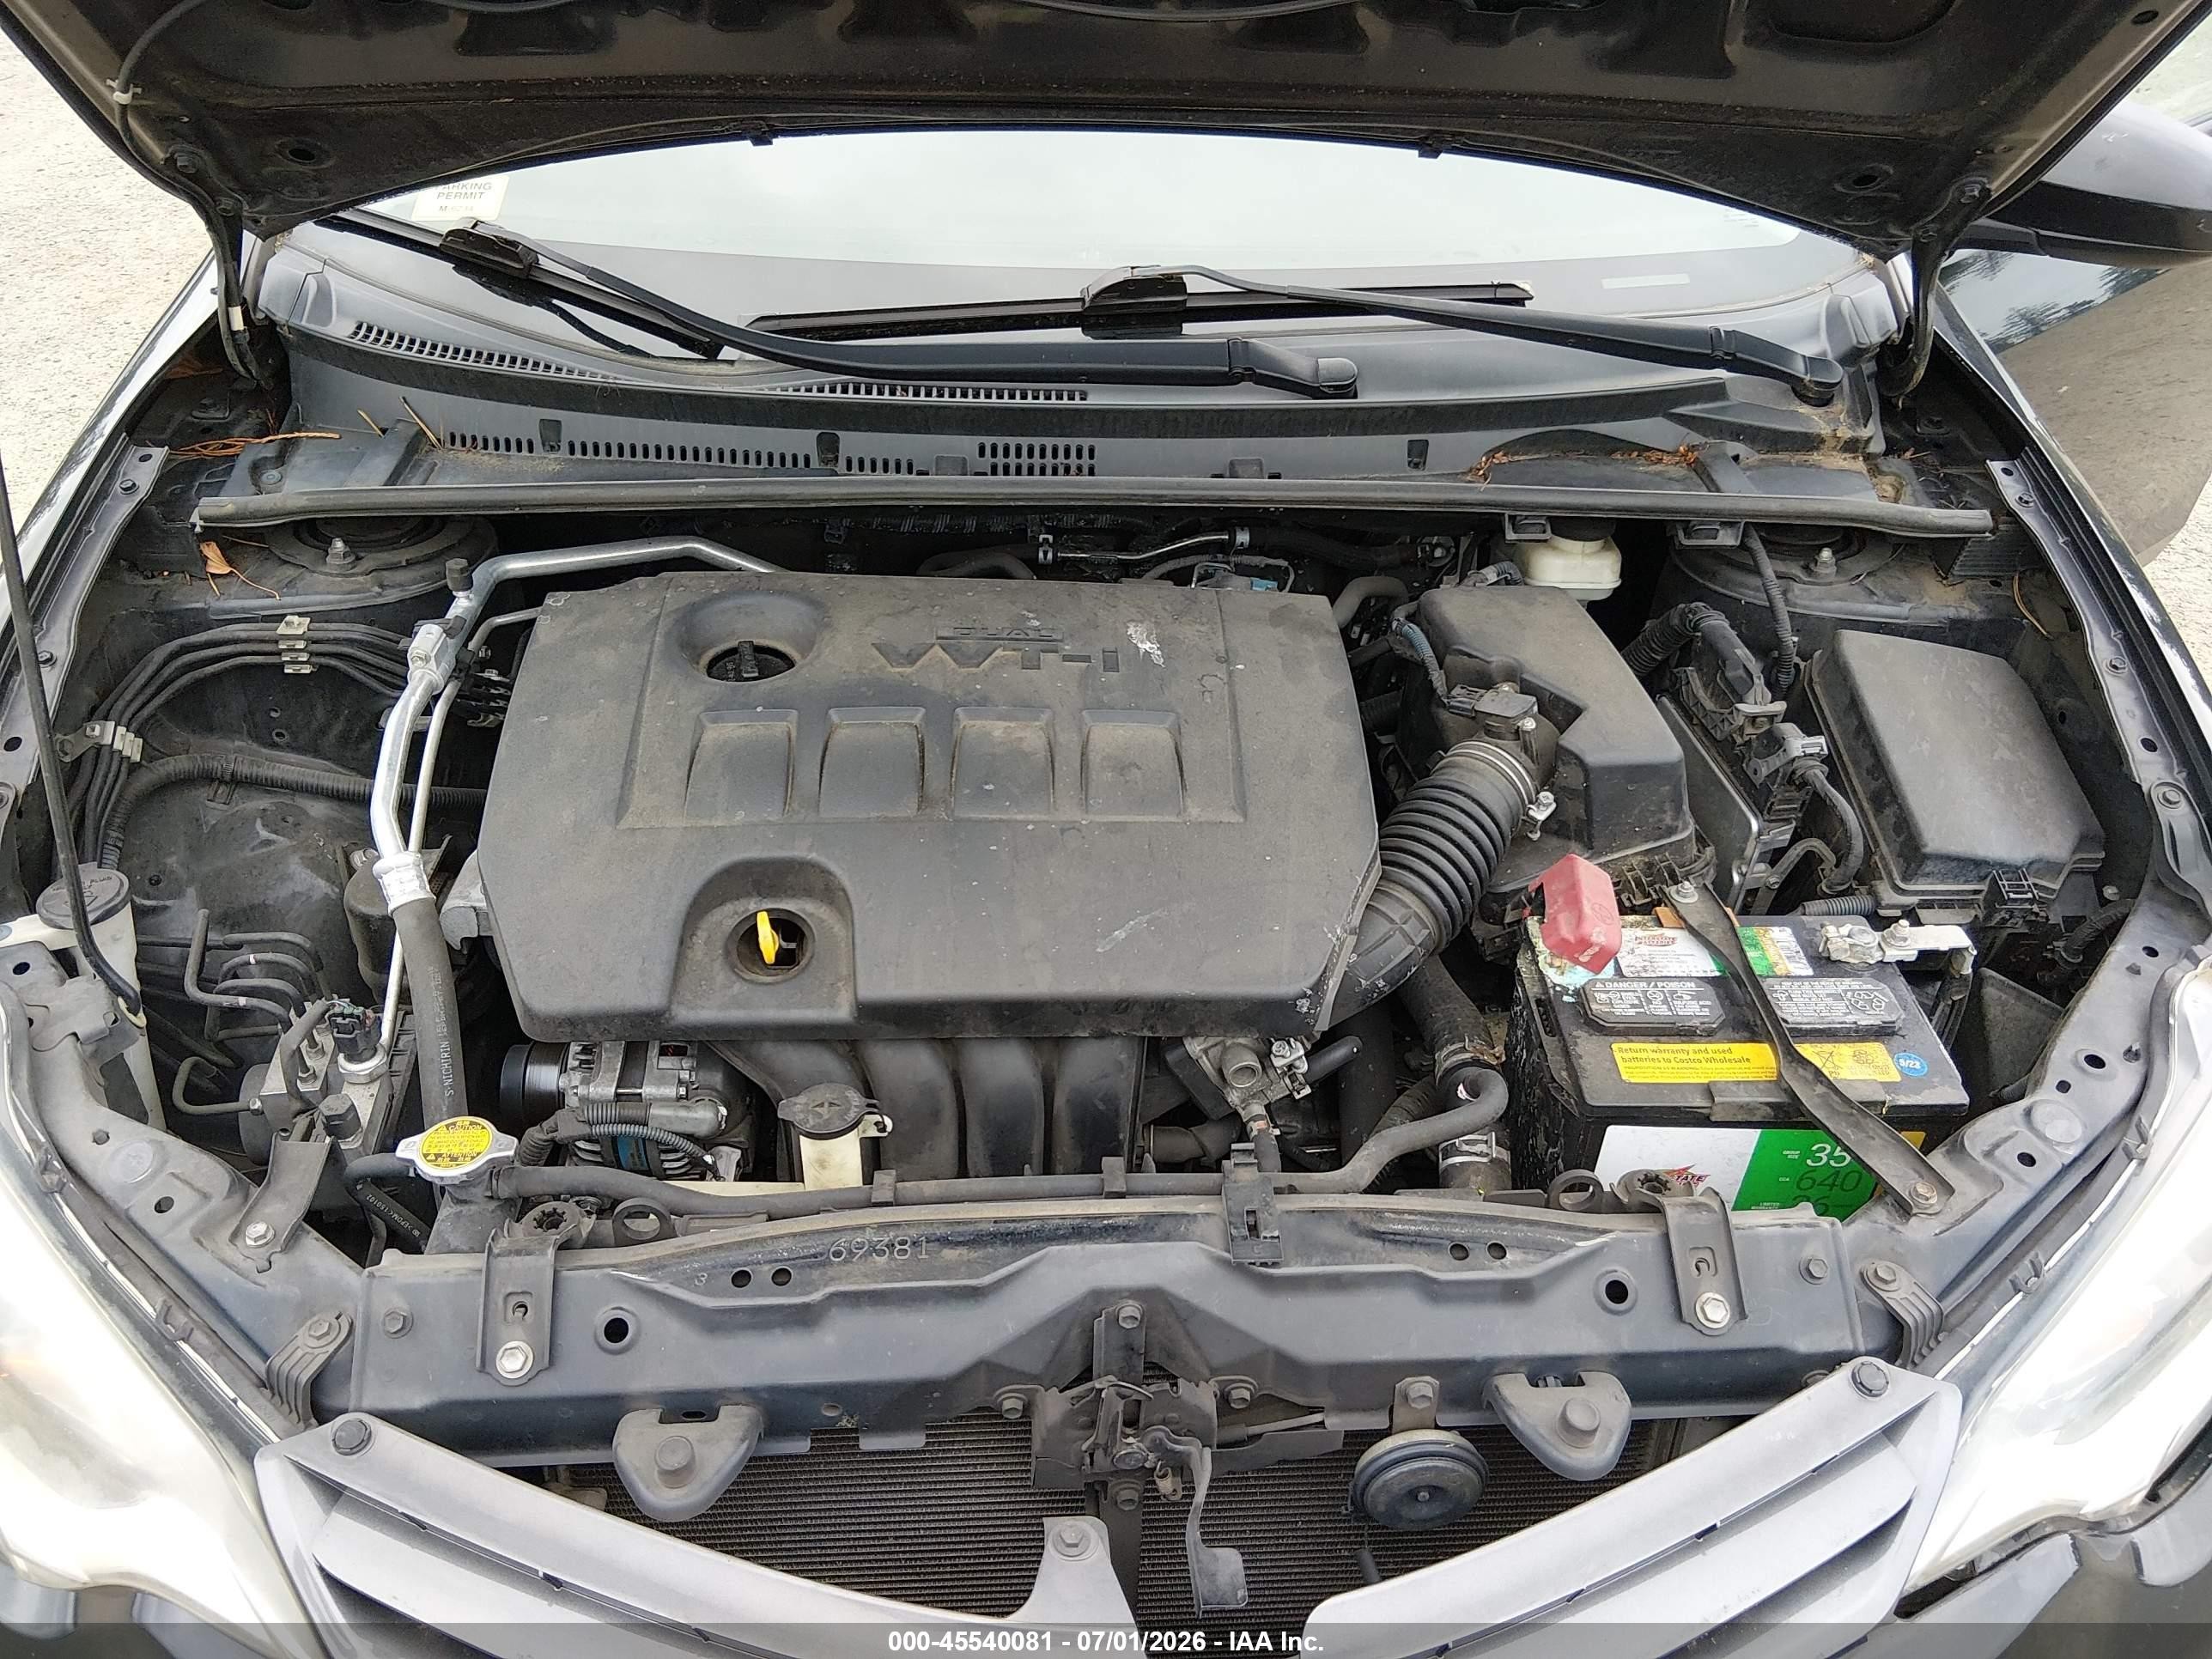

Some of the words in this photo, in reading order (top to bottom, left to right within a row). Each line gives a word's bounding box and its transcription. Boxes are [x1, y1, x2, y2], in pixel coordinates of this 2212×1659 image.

[436, 191, 485, 200] PERMIT
[1650, 1048, 1690, 1056] warranty
[1806, 1143, 1852, 1167] 35
[1796, 1170, 1863, 1192] 640
[829, 1236, 929, 1262] 69381
